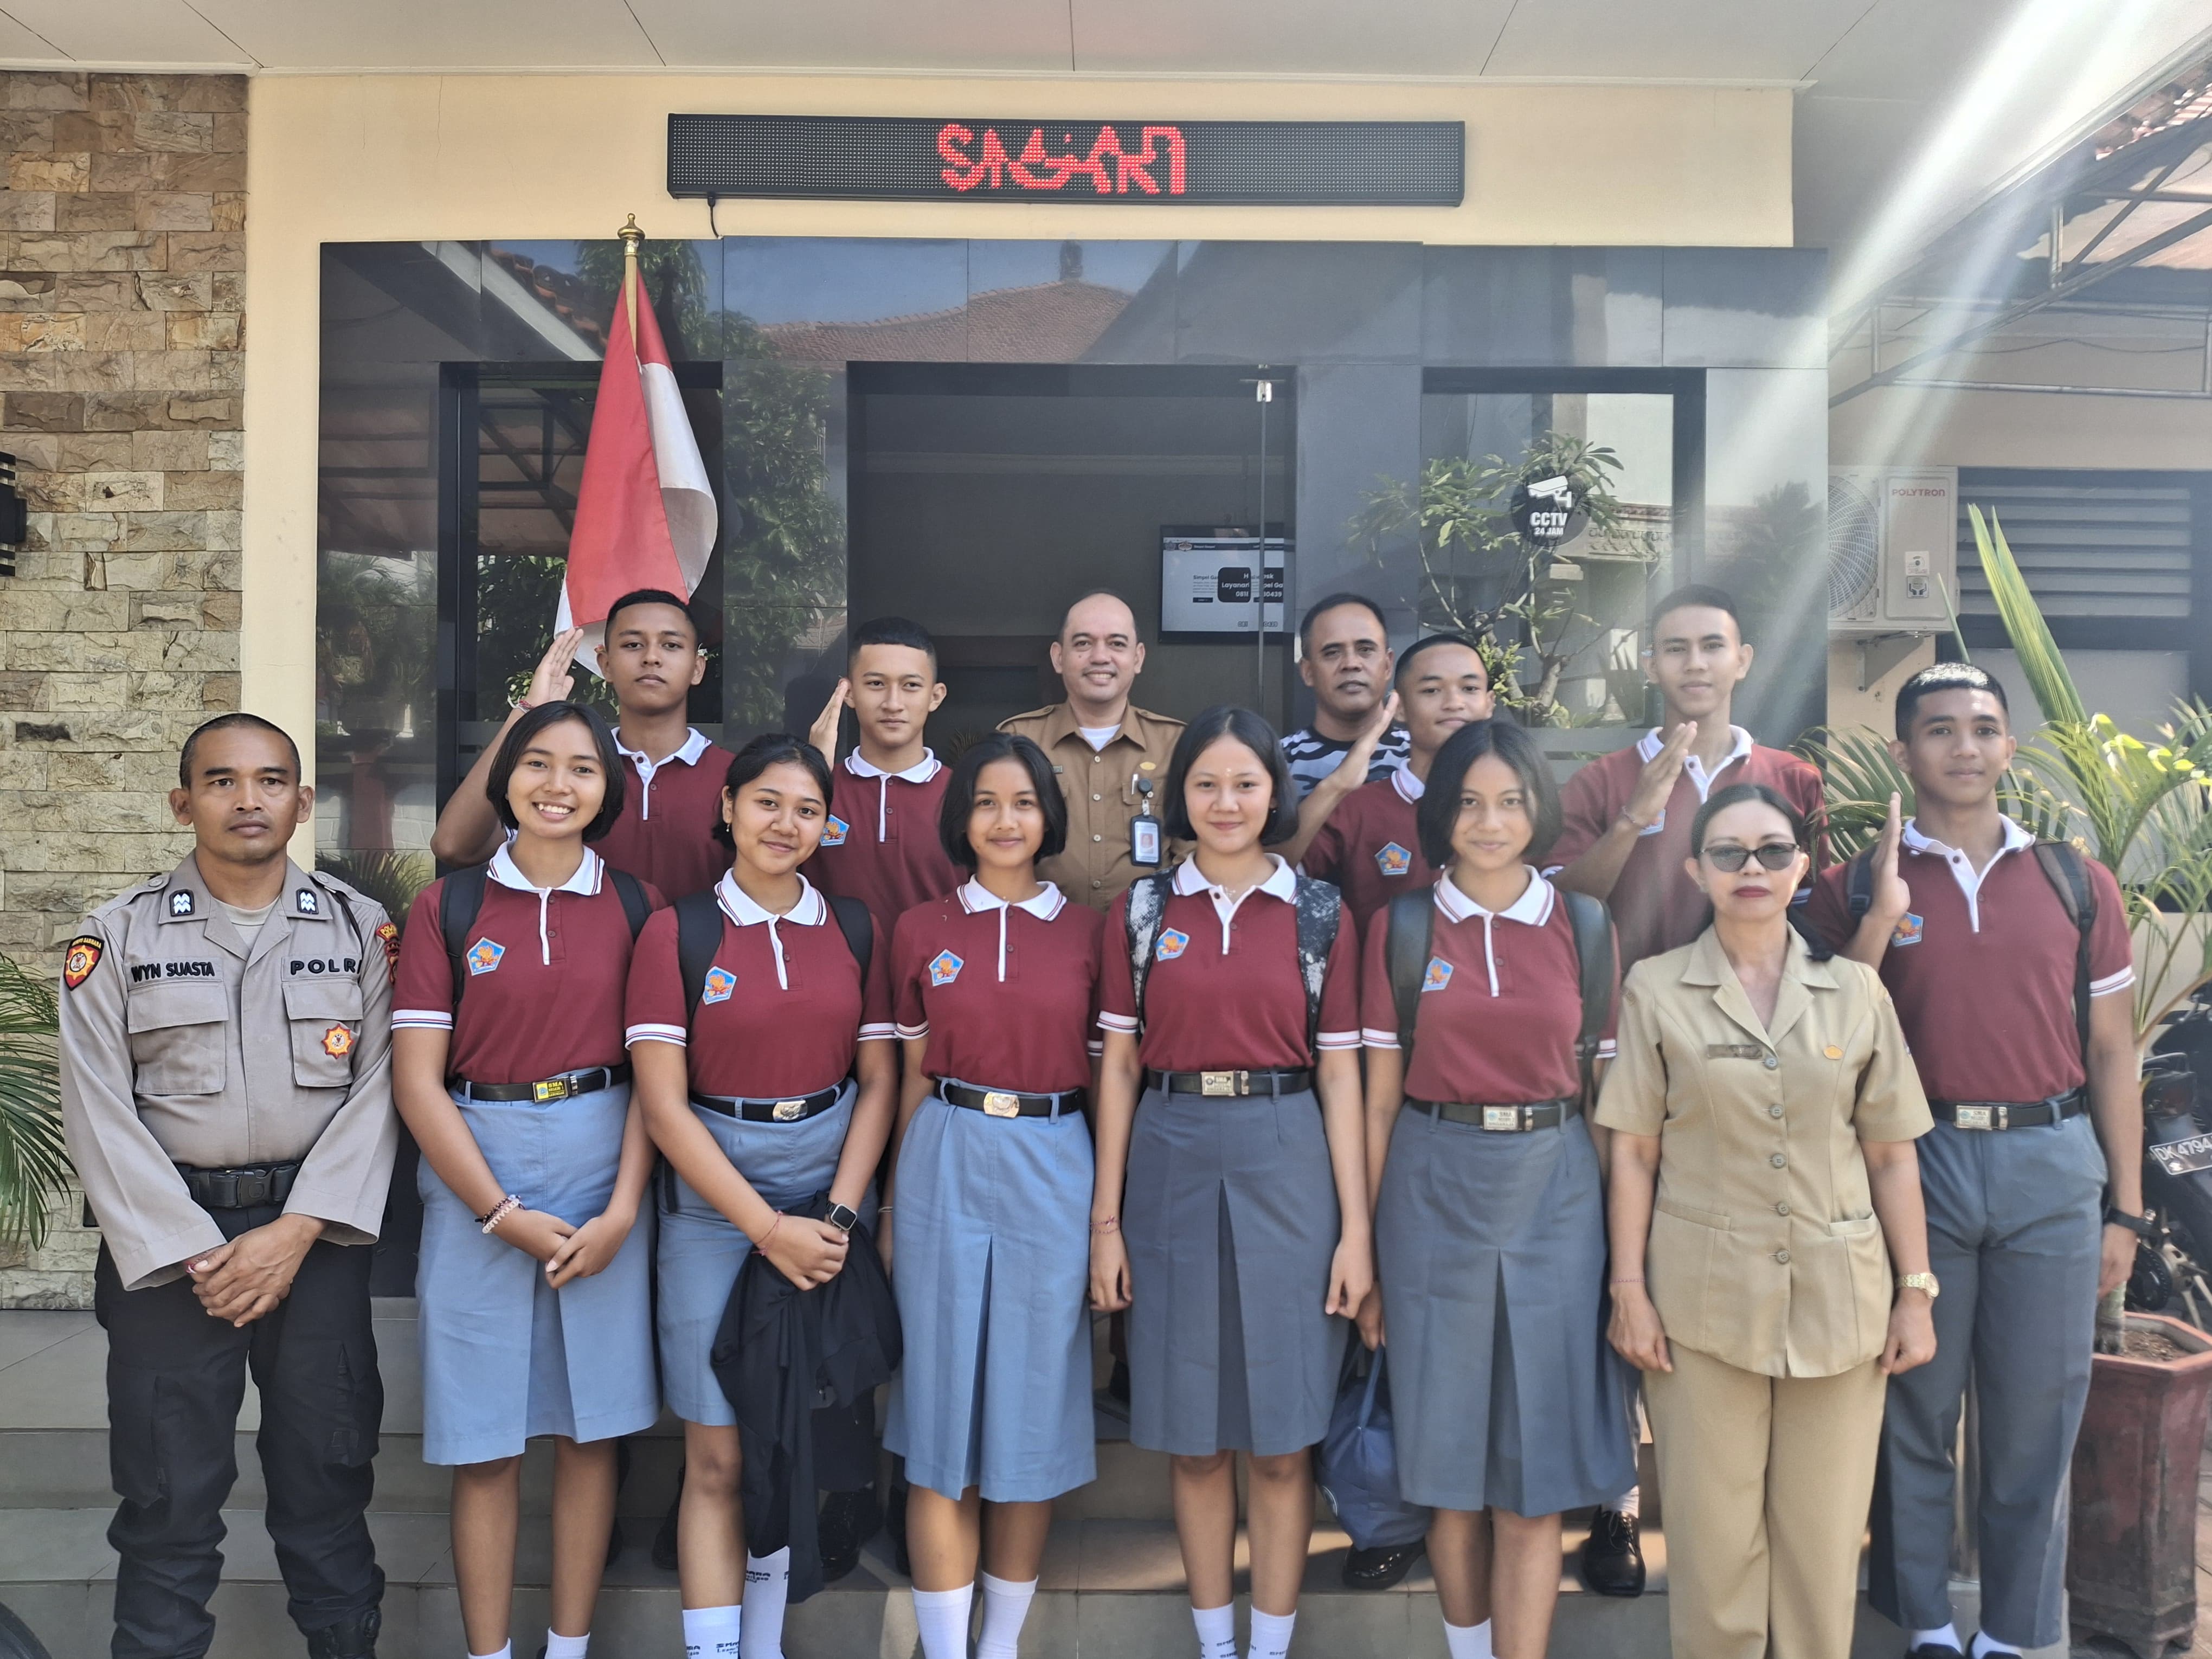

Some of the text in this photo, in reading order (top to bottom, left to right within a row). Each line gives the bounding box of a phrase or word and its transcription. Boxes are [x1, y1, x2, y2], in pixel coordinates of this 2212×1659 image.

[1530, 512, 1568, 526] CCTV
[1534, 527, 1564, 536] 24 JAM
[131, 961, 215, 982] WYN SUASTA
[2154, 1137, 2212, 1160] DK 4794
